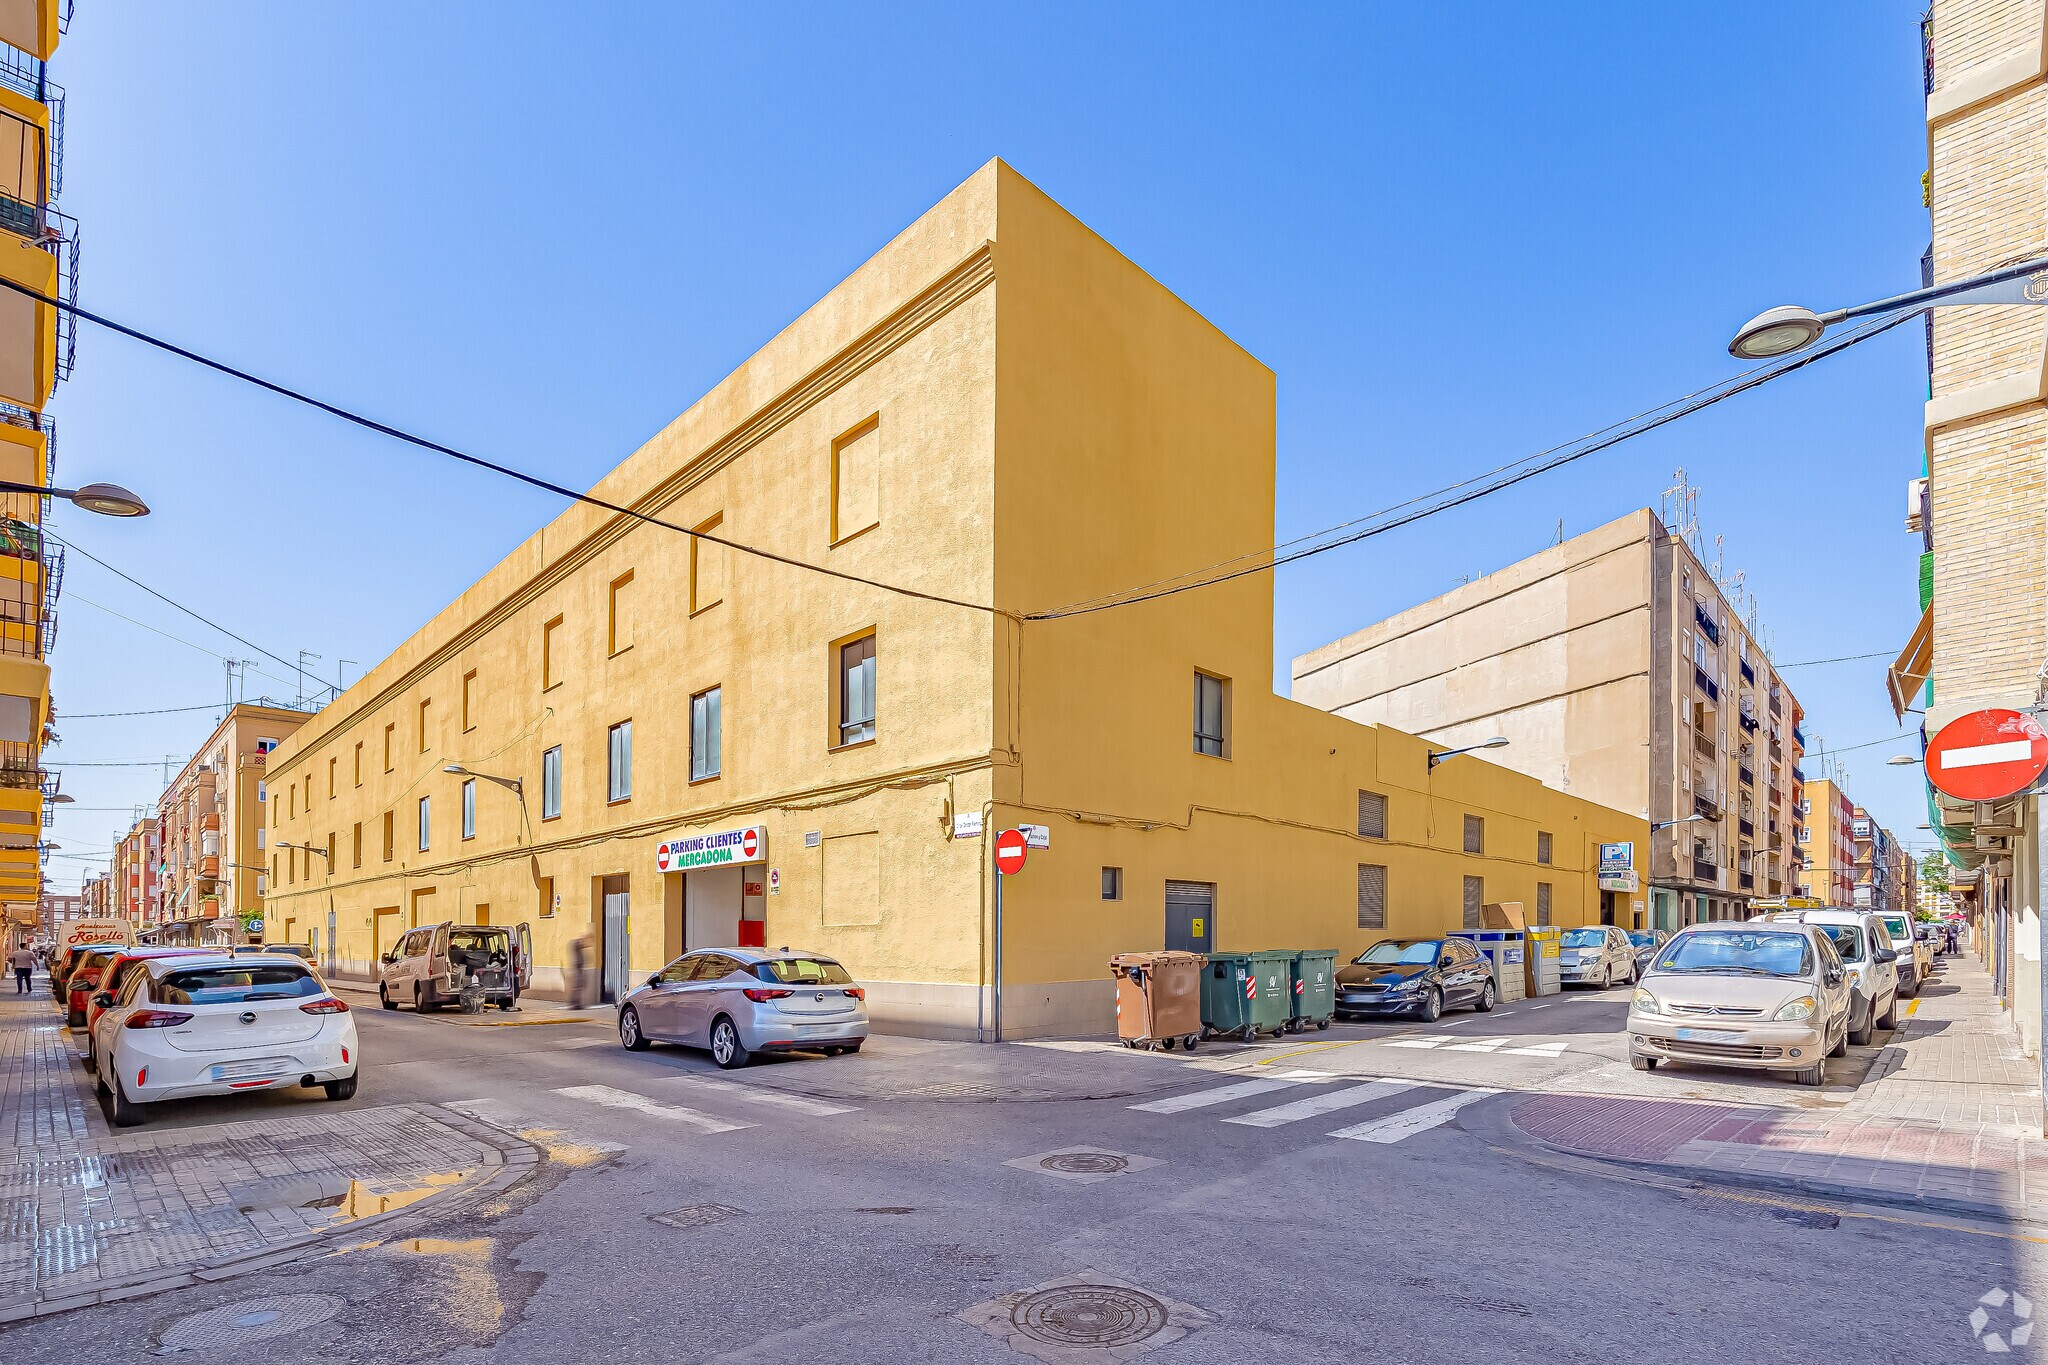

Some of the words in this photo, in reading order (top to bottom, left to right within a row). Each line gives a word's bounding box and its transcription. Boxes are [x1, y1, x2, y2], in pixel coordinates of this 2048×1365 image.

[671, 838, 704, 855] PARKING
[706, 831, 743, 849] CLIENTES
[677, 847, 733, 868] MERCADONA
